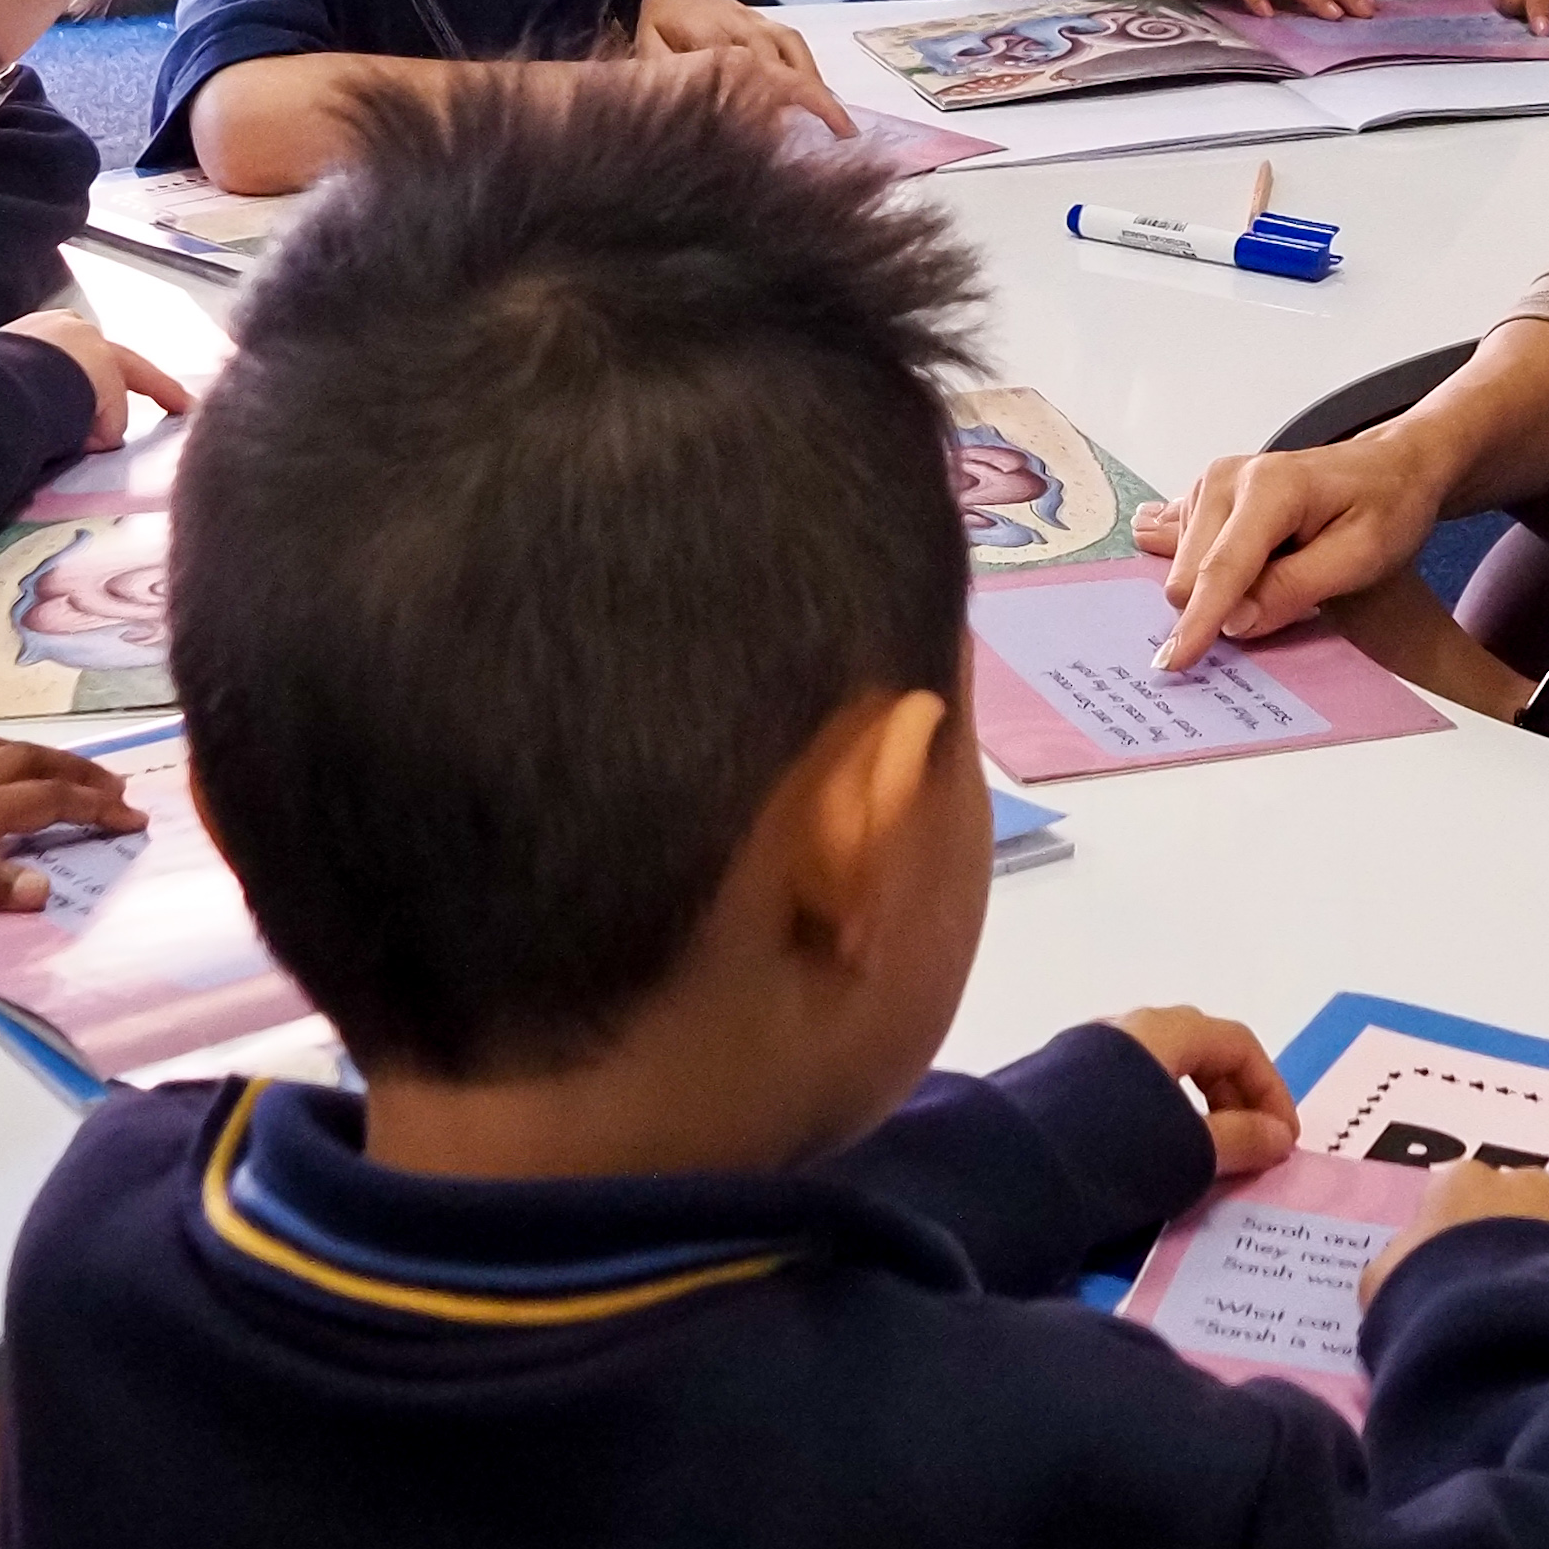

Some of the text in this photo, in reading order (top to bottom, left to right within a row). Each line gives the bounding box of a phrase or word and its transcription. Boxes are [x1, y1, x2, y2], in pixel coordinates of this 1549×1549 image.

[1242, 1217, 1370, 1249] Sarah and
[1236, 1236, 1288, 1259] They
[1222, 1255, 1292, 1280] Sarah
